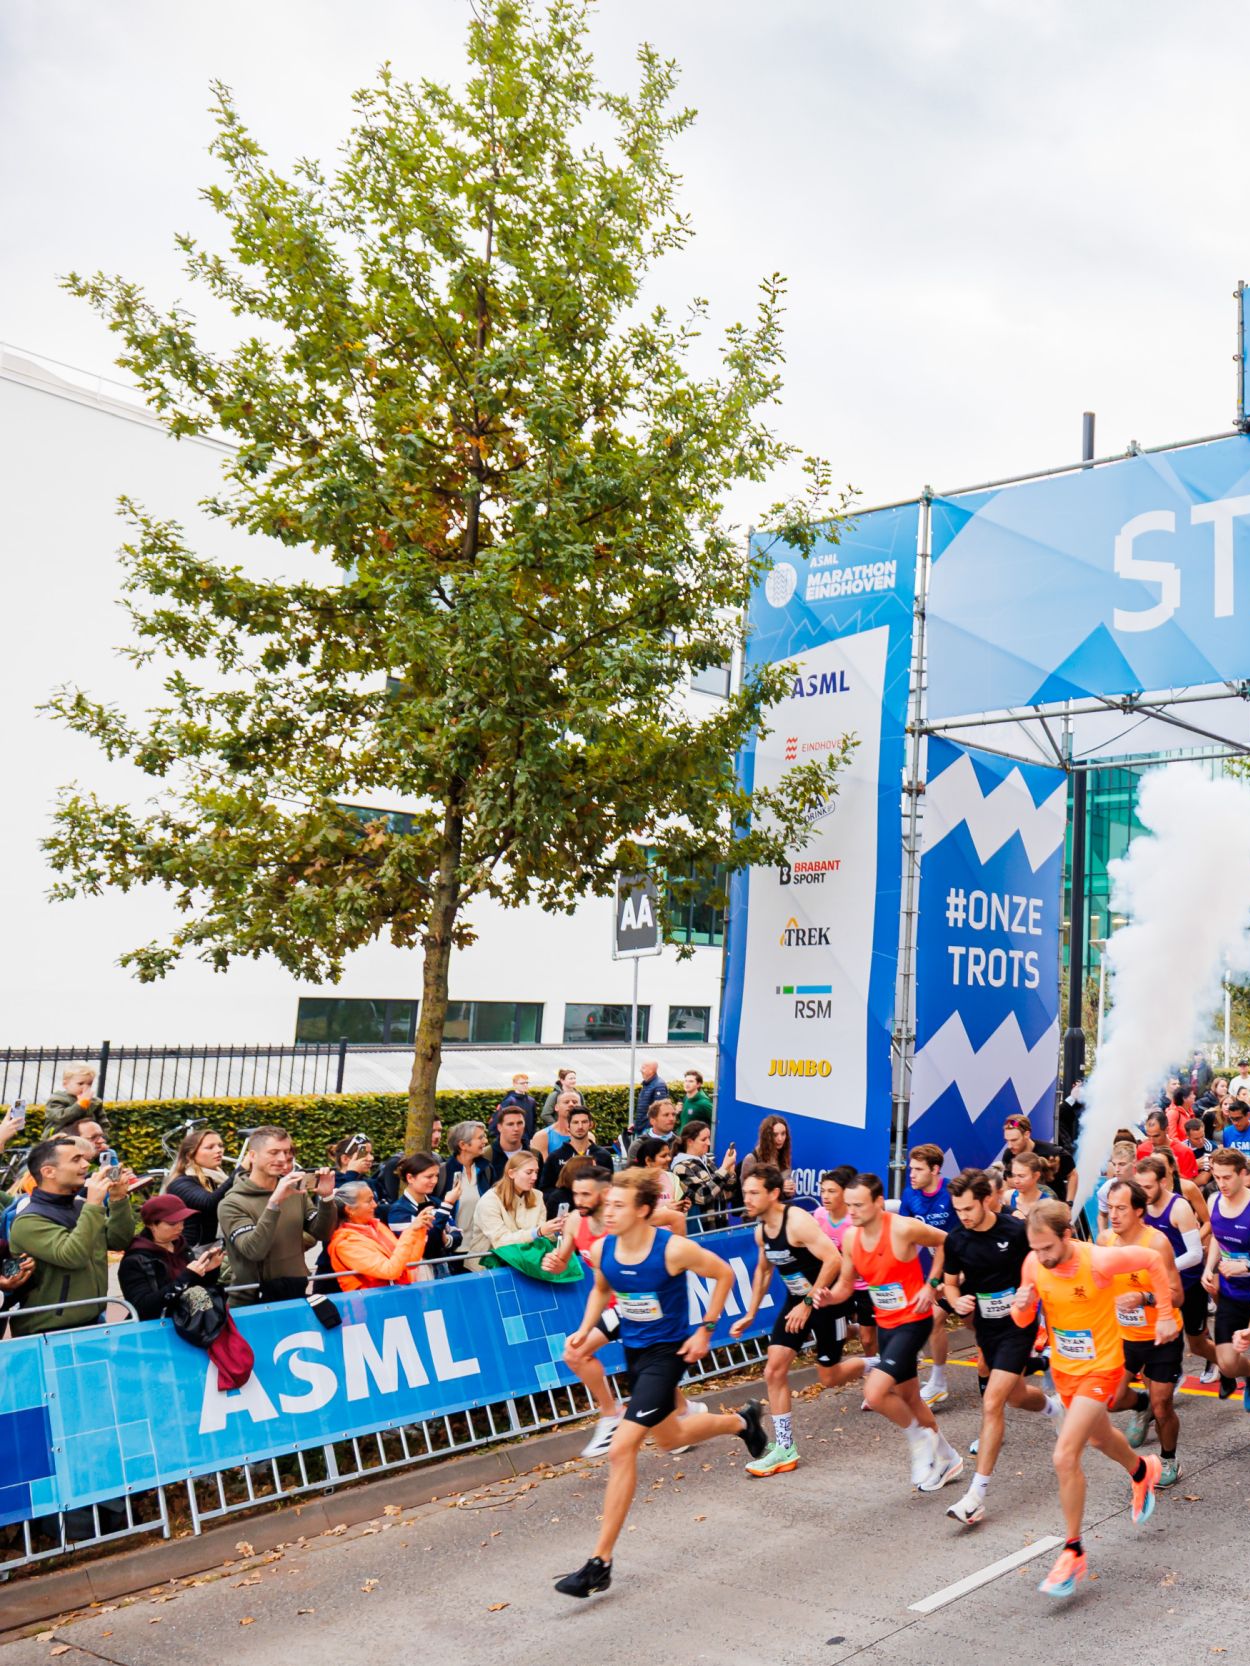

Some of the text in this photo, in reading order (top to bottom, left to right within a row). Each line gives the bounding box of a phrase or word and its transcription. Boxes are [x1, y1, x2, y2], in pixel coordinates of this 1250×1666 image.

[809, 553, 839, 568] ASML
[807, 560, 897, 588] MARATHON
[805, 574, 896, 601] EINDHOVEN
[790, 670, 850, 699] ASML
[801, 740, 848, 752] EINDHOVE
[794, 860, 841, 873] BRABANT
[793, 872, 826, 885] SPORT
[620, 894, 654, 932] AA
[945, 887, 1044, 936] #ONZE
[784, 927, 831, 947] TREK
[947, 945, 1040, 989] TROTS
[794, 1000, 832, 1019] RSM
[767, 1059, 833, 1078] JUMBO
[198, 1309, 481, 1435] ASML
